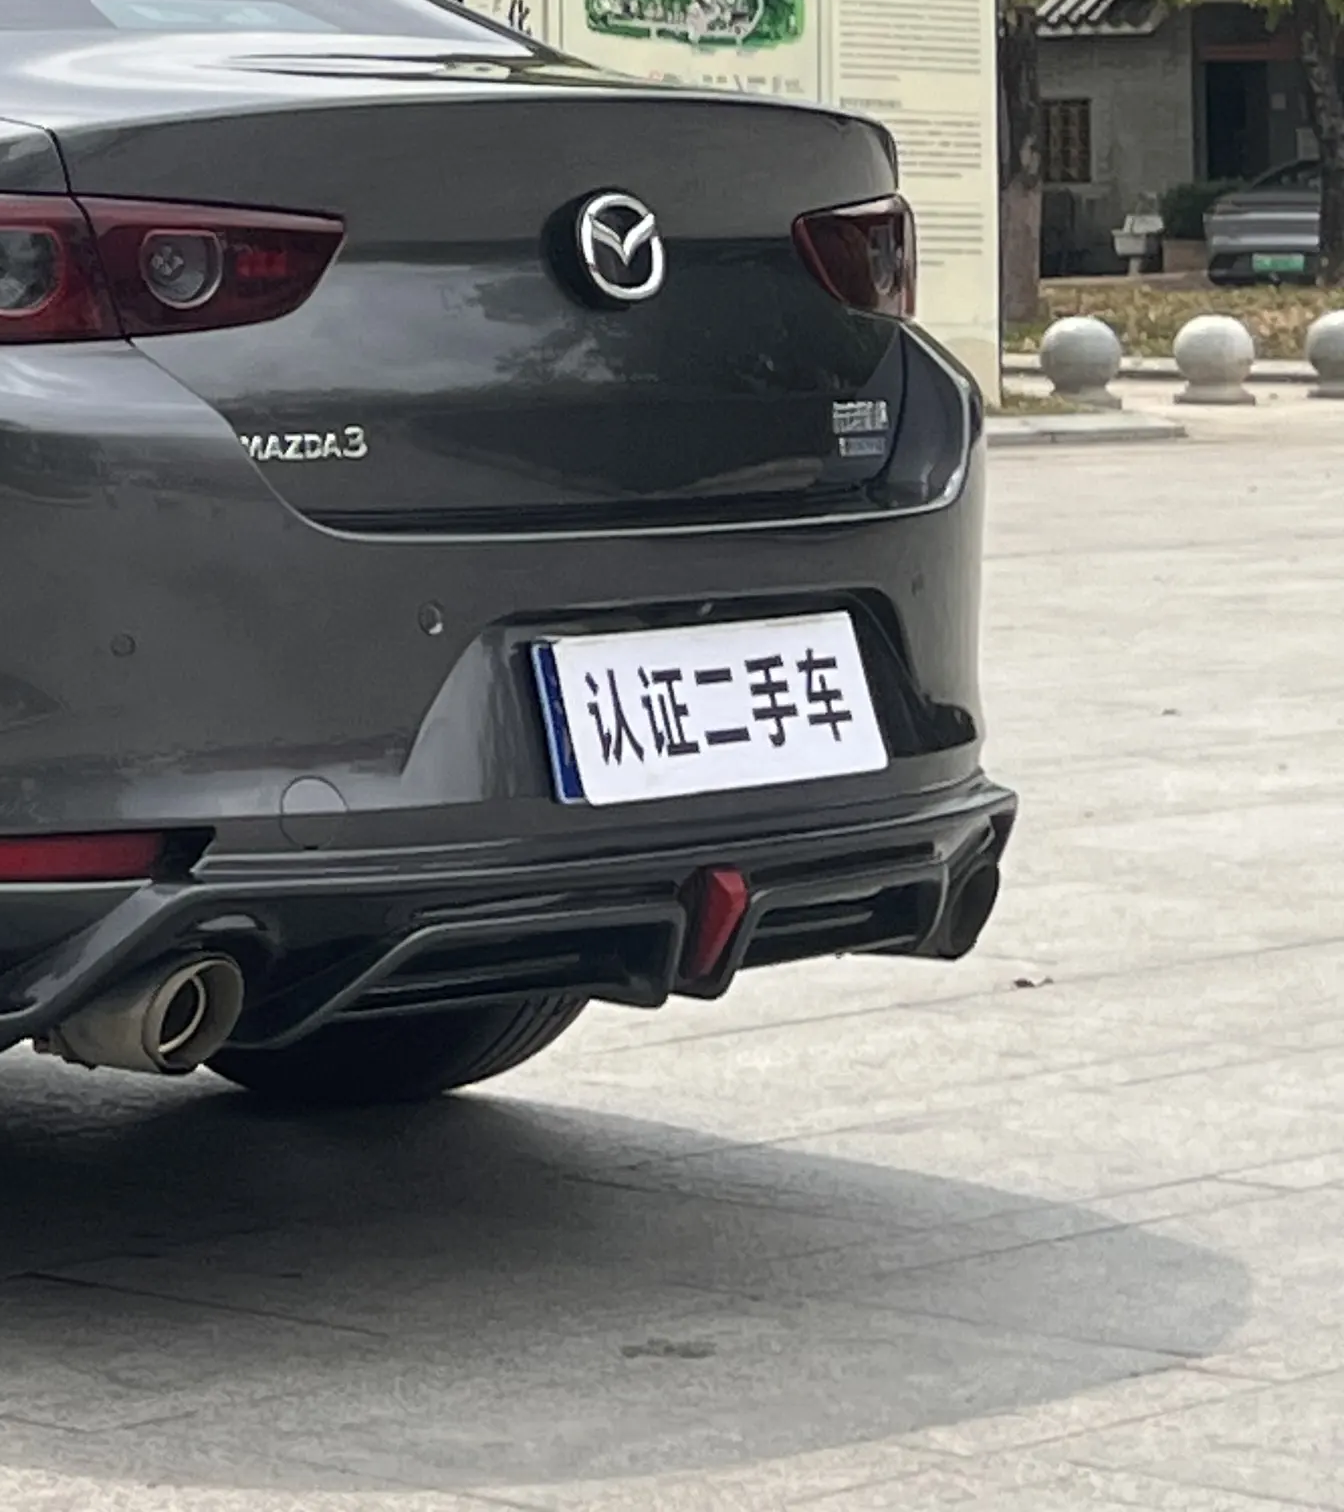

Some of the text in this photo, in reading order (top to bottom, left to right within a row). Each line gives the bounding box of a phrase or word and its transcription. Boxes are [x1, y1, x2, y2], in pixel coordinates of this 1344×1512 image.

[240, 426, 368, 461] MAZDA3
[585, 648, 852, 765] 认证二手车
